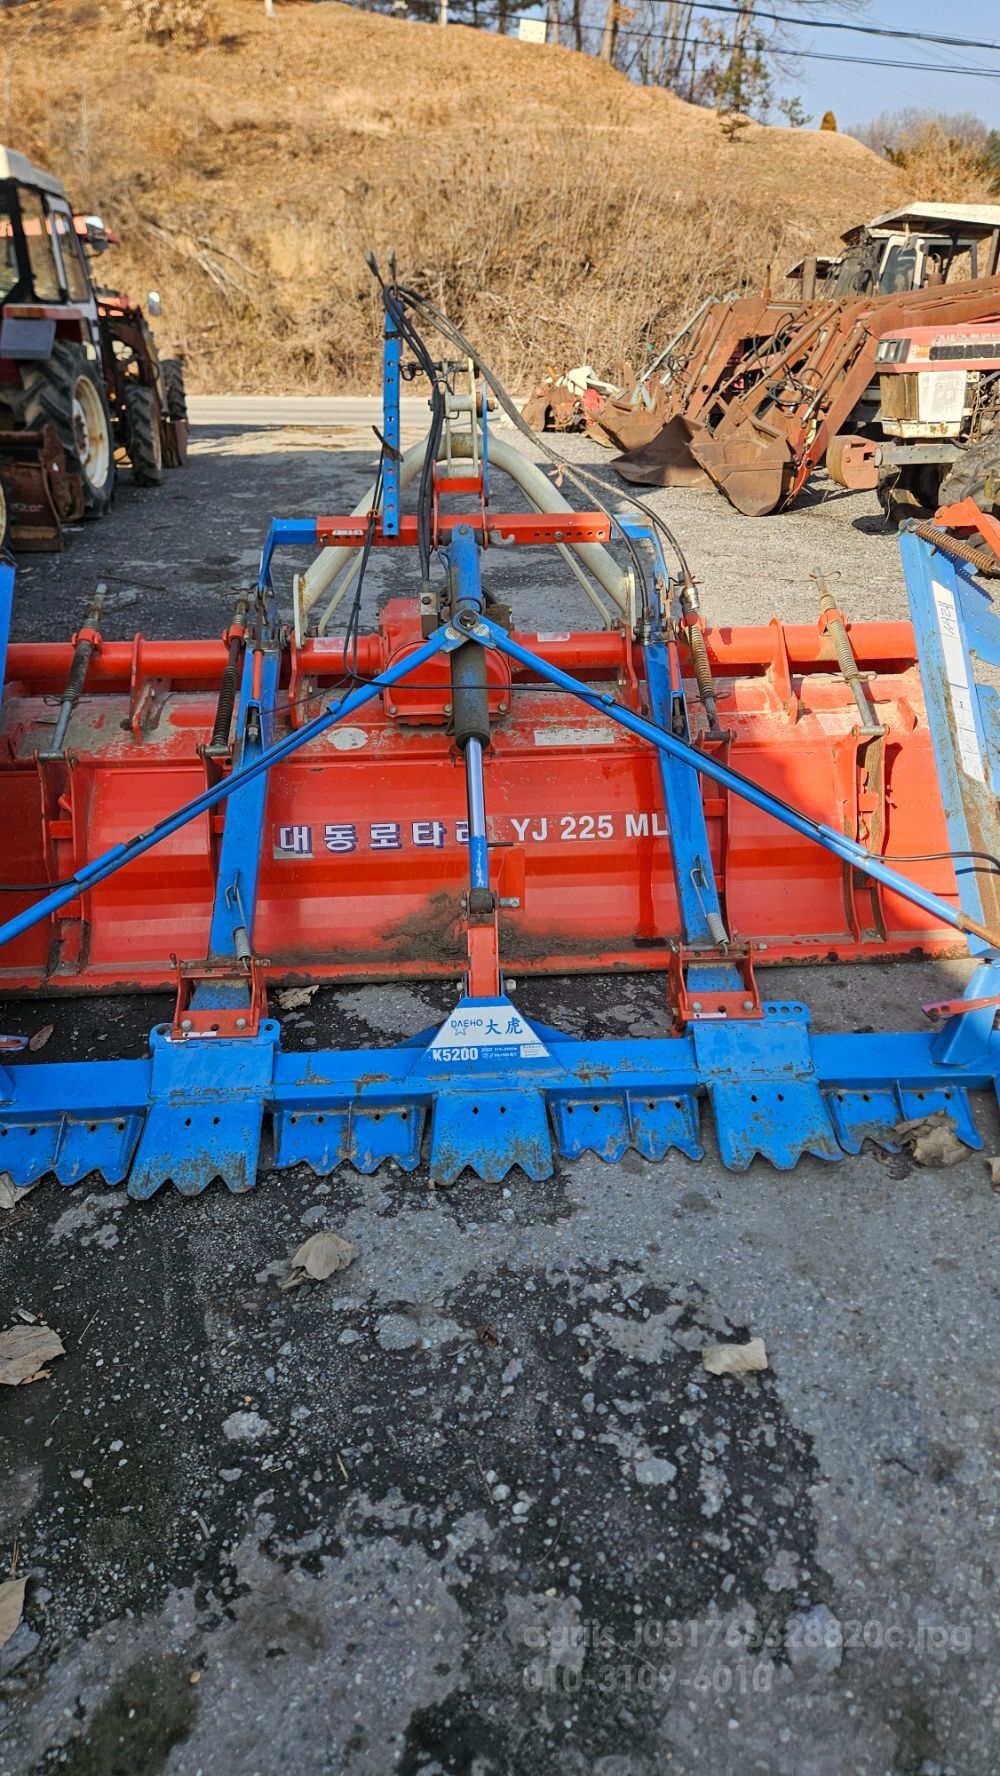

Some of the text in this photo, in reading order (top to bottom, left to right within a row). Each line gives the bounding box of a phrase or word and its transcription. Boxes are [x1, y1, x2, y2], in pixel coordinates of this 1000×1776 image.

[511, 812, 670, 842] YJ 225 ML
[450, 1018, 483, 1028] DAEHO
[485, 1016, 523, 1035] 大虎
[432, 1047, 479, 1062] K5200
